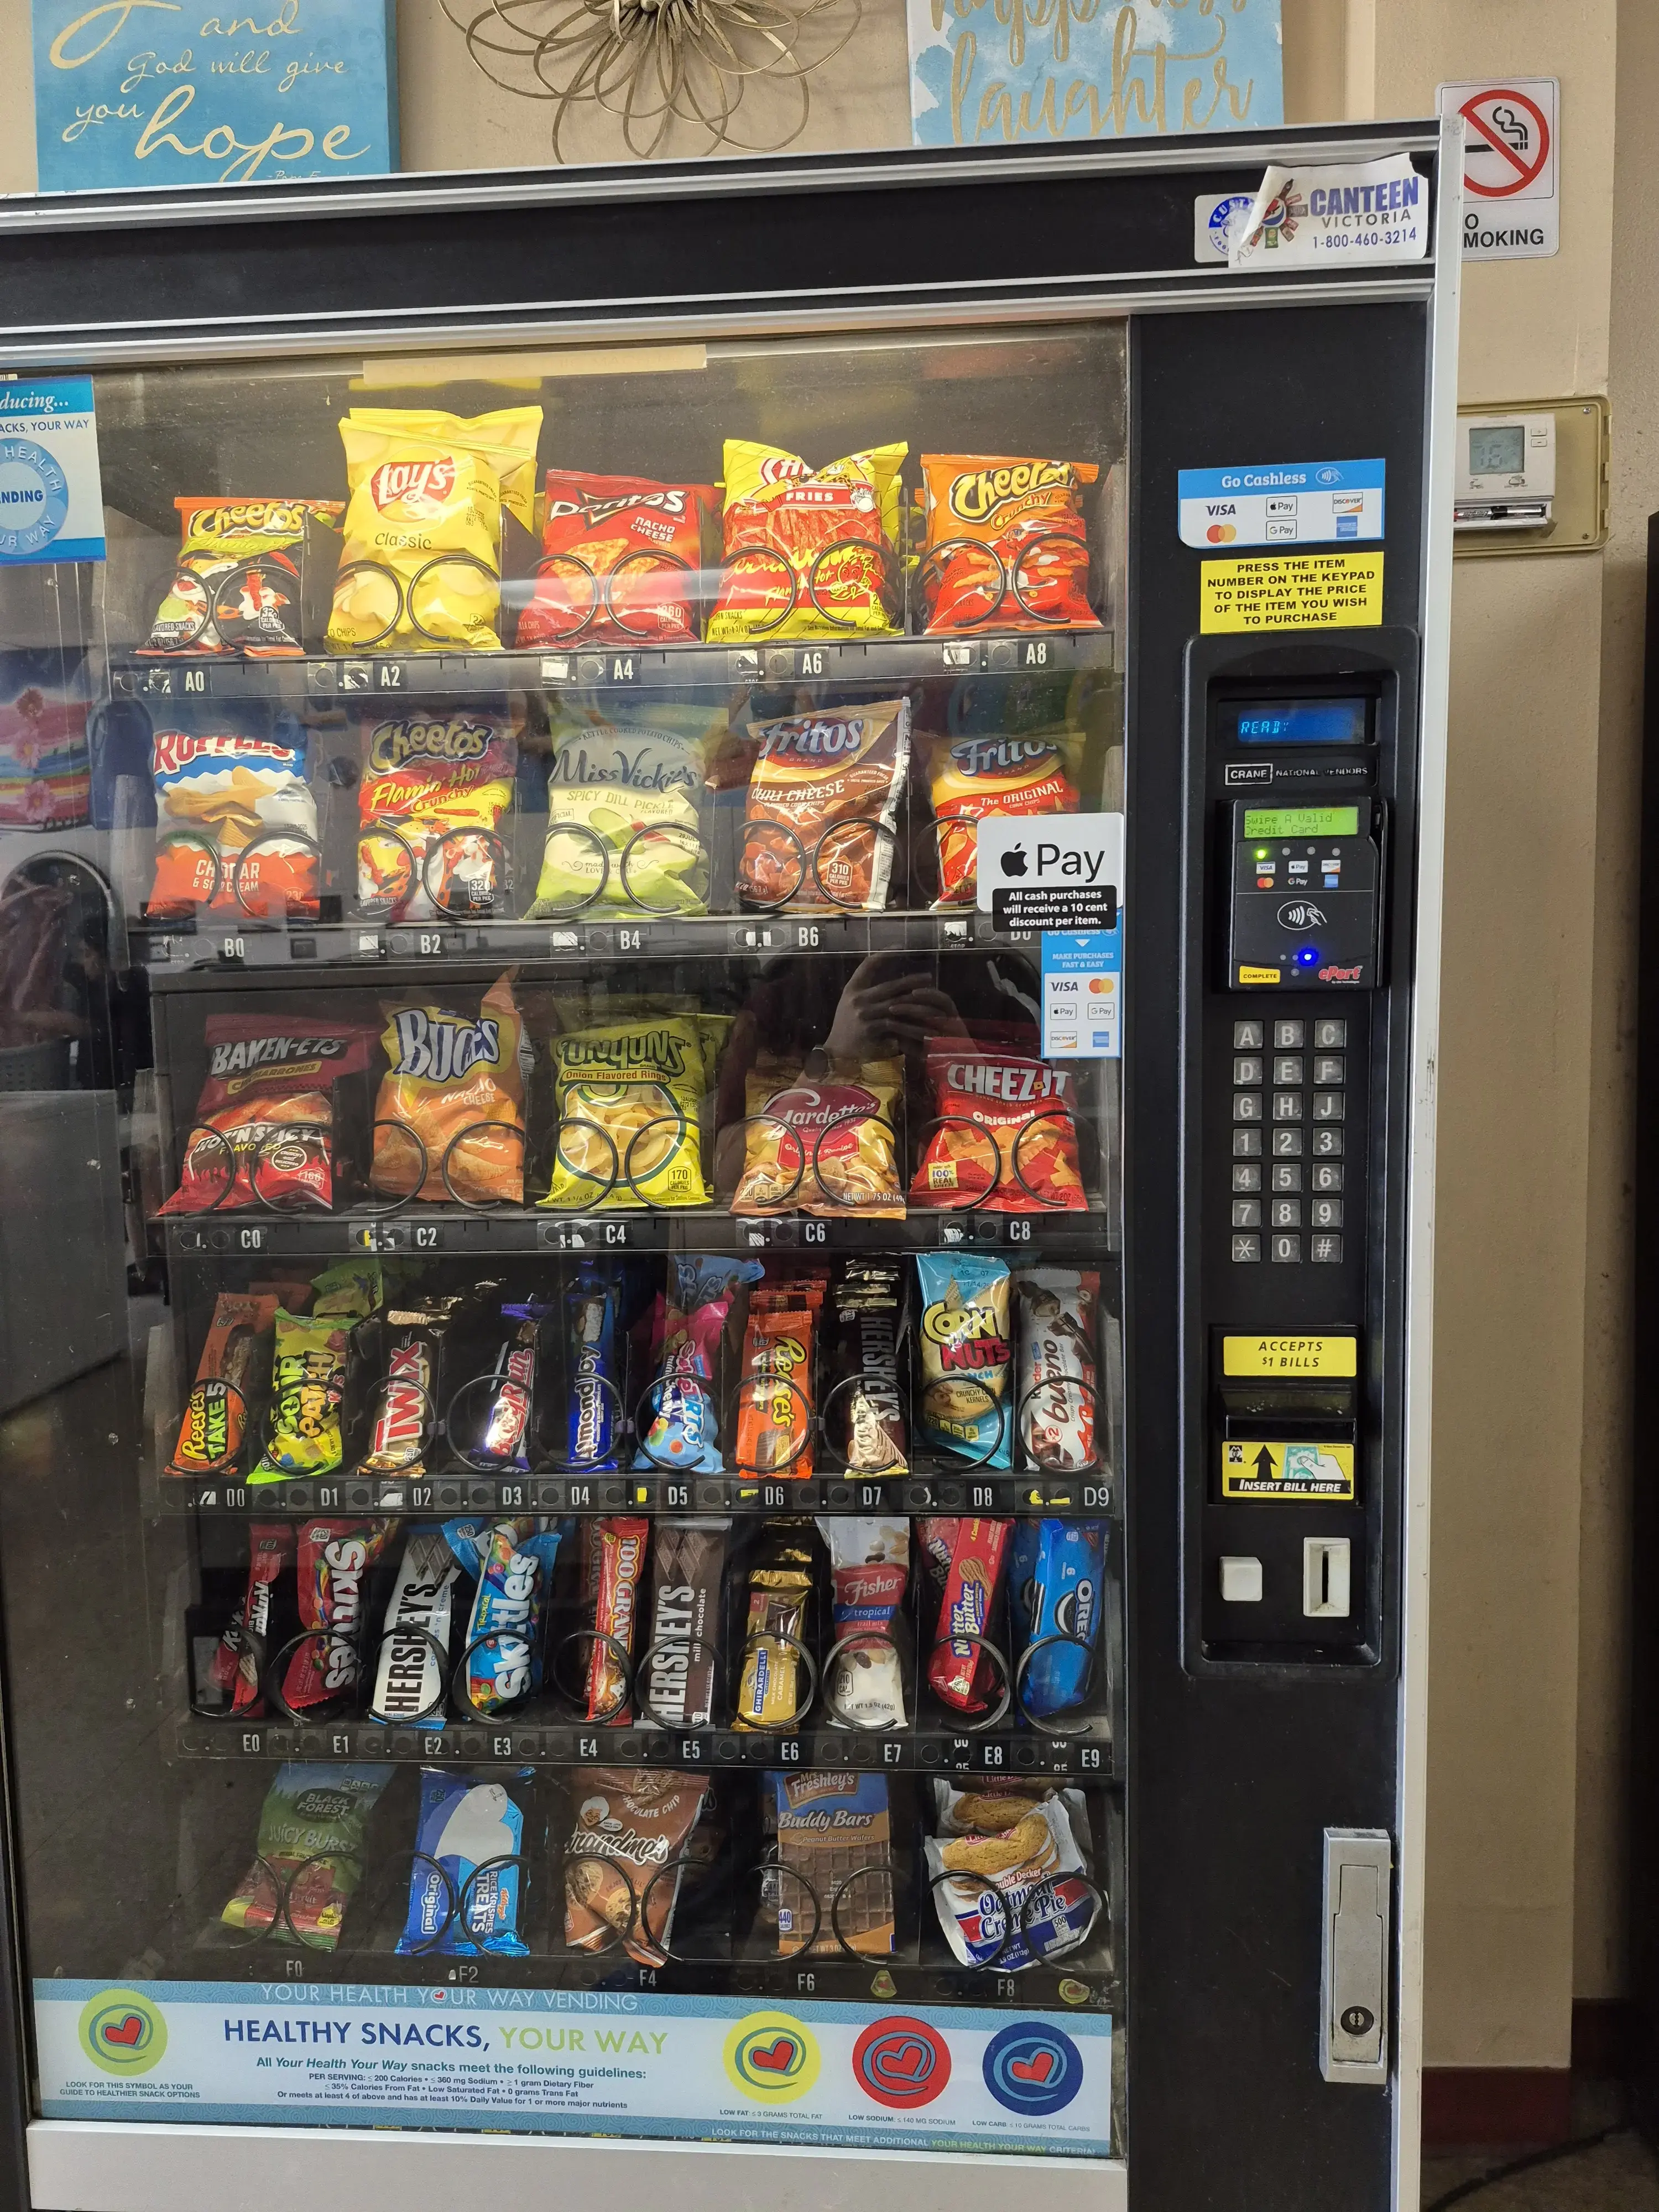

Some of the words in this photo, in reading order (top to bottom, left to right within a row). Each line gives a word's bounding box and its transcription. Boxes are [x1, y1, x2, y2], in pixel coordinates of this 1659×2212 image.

[200, 0, 301, 36] and
[121, 49, 192, 93] God
[211, 50, 270, 73] will
[287, 53, 348, 92] give
[62, 103, 145, 142] you
[134, 85, 371, 181] hope
[1310, 176, 1419, 215] CANTEEN
[1322, 209, 1411, 228] VICTORIA
[1312, 227, 1417, 249] 1-800-460-3214
[1463, 229, 1544, 248] MOKING
[32, 421, 61, 431] YOUR
[65, 419, 90, 430] WAY
[379, 456, 454, 506] Lay's
[1222, 476, 1240, 488] Go
[1244, 472, 1306, 487] Cashless
[786, 492, 834, 502] FRIES
[550, 490, 686, 525] Doritos
[1206, 504, 1236, 516] VISA
[191, 501, 304, 535] Cheetos
[635, 517, 676, 534] NACHO
[375, 533, 431, 550] Classic
[630, 524, 674, 542] CHEESE
[1237, 562, 1279, 573] PRESS
[1284, 561, 1310, 570] THE
[1314, 559, 1345, 569] ITEM
[1207, 576, 1264, 587] NUMBER
[1268, 575, 1287, 585] ON
[1291, 574, 1317, 583] THE
[1322, 571, 1375, 582] KEYPAD
[1215, 591, 1233, 600] TO
[1237, 588, 1292, 599] DISPLAY
[1297, 587, 1323, 596] THE
[1327, 584, 1366, 594] PRICE
[1214, 604, 1231, 613] OF
[1235, 603, 1261, 612] THE
[1265, 601, 1296, 611] ITEM
[1301, 599, 1328, 609] YOU
[1333, 597, 1367, 607] WISH
[1244, 615, 1261, 624] TO
[1265, 612, 1337, 624] PURCHASE
[1026, 643, 1047, 664] A8
[582, 729, 608, 740] KETTLE
[638, 728, 662, 739] POTATO
[662, 735, 683, 749] CHIPS
[550, 749, 617, 783] Miss
[613, 748, 697, 793] Vickie's
[1230, 769, 1267, 779] CRANE
[567, 790, 601, 802] SPICY
[605, 794, 628, 807] DILL
[634, 799, 673, 810] PICKLE
[980, 797, 999, 806] The
[1003, 780, 1063, 804] ORIGINAL
[1245, 815, 1278, 825] Swipe
[1285, 815, 1292, 823] A
[1298, 813, 1333, 823] Valid
[1245, 826, 1284, 836] Credit
[1291, 825, 1318, 834] Card
[1037, 843, 1105, 883] Pay
[1009, 891, 1023, 901] All
[1025, 890, 1048, 901] cash
[1050, 889, 1102, 902] purchases
[1003, 904, 1021, 914] will
[1023, 904, 1060, 914] receive
[1070, 903, 1083, 912] 10
[1085, 903, 1108, 912] cent
[1009, 917, 1053, 927] discount
[1055, 918, 1073, 928] per
[1074, 916, 1101, 925] item.
[420, 935, 441, 954] B2
[1318, 966, 1361, 982] ePort
[211, 1037, 348, 1075] BAKEN-ETS
[566, 1071, 593, 1079] Onion
[597, 1071, 637, 1079] Flavored
[641, 1071, 667, 1081] Rings
[241, 1230, 260, 1248] C0
[1010, 1221, 1030, 1240] C8
[941, 1338, 1010, 1370] NUTS
[1259, 1341, 1323, 1352] ACCEPTS
[1262, 1357, 1273, 1367] $1
[1280, 1357, 1319, 1368] BILLS
[207, 1383, 226, 1396] 5
[374, 1342, 423, 1453] TWIX
[956, 1388, 980, 1398] CRUNCHY
[966, 1395, 989, 1404] KERNELS
[208, 1399, 226, 1461] TAKE
[1239, 1479, 1281, 1492] INSERT
[1284, 1481, 1308, 1492] BILL
[1311, 1483, 1341, 1493] HERE
[1084, 1486, 1109, 1507] D9
[844, 1575, 902, 1605] Fisher
[854, 1608, 890, 1618] tropical
[384, 1583, 438, 1713] HERSHEY'S
[755, 1650, 767, 1714] GHIRARDELLI
[791, 1773, 855, 1797] Freshley's
[297, 1802, 349, 1814] FOREST
[306, 1793, 349, 1804] BLACK
[779, 1812, 831, 1831] Buddy
[833, 1811, 872, 1827] Bars
[424, 1874, 440, 1931] Original
[472, 1872, 489, 1933] TREATS
[459, 1966, 478, 1983] F2
[261, 1984, 319, 2001] YOUR
[331, 1985, 407, 2003] HEALTH
[417, 1987, 477, 2005] YOUR
[487, 1990, 534, 2007] WAY
[544, 1991, 638, 2010] VENDING
[225, 2019, 352, 2043] HEALTHY
[362, 2022, 490, 2052] SNACKS,
[498, 2027, 586, 2051] YOUR
[594, 2030, 669, 2054] WAY
[257, 2057, 272, 2067] All
[276, 2057, 302, 2068] Your
[306, 2058, 347, 2069] Health
[351, 2059, 378, 2069] Your
[382, 2059, 408, 2073] Way
[411, 2061, 455, 2072] snacks
[459, 2063, 491, 2073] meet
[493, 2064, 514, 2074] the
[517, 2064, 575, 2078] following
[578, 2066, 646, 2079] guidelines:
